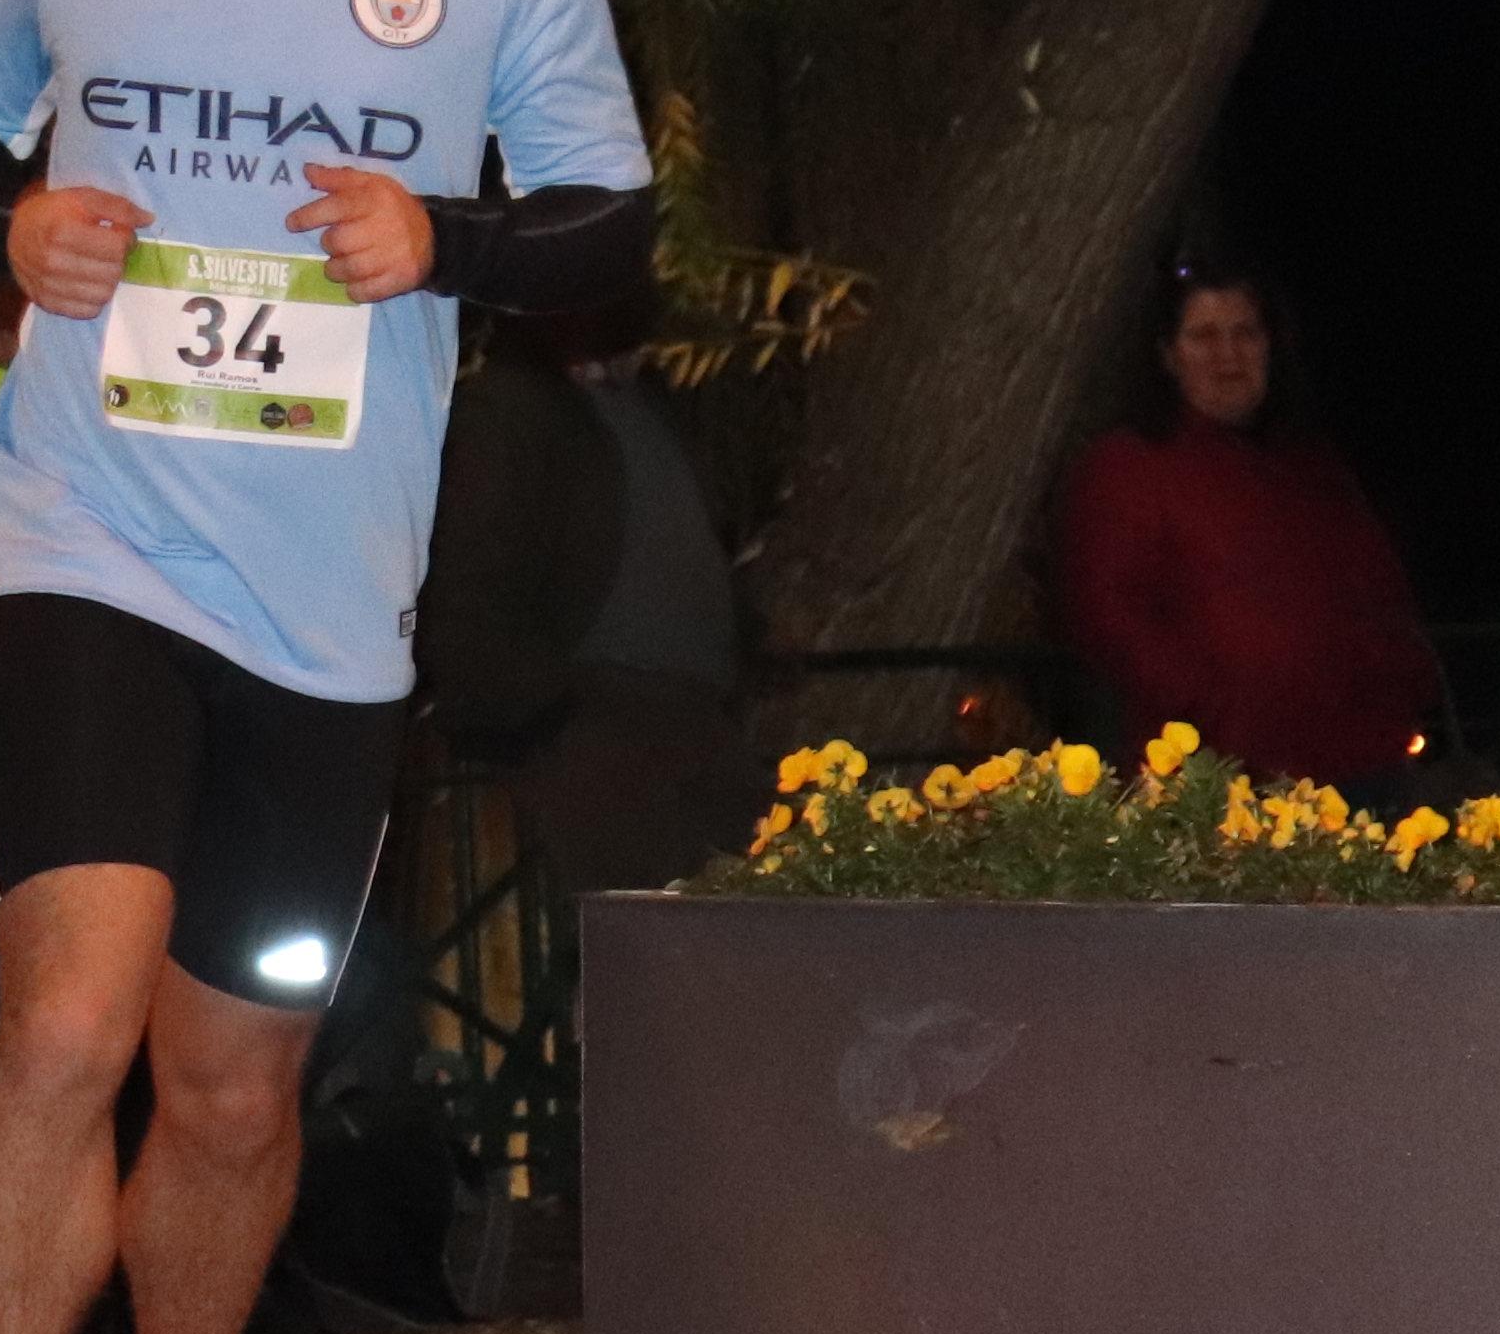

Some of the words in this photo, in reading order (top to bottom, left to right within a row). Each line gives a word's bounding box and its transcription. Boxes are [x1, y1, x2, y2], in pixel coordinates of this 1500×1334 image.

[382, 28, 410, 40] CITY
[82, 77, 423, 161] ETIHAD
[135, 145, 294, 186] AIRWA
[187, 253, 290, 287] S.SILVESTRE
[177, 296, 285, 374] 34
[219, 371, 258, 384] Ramos
